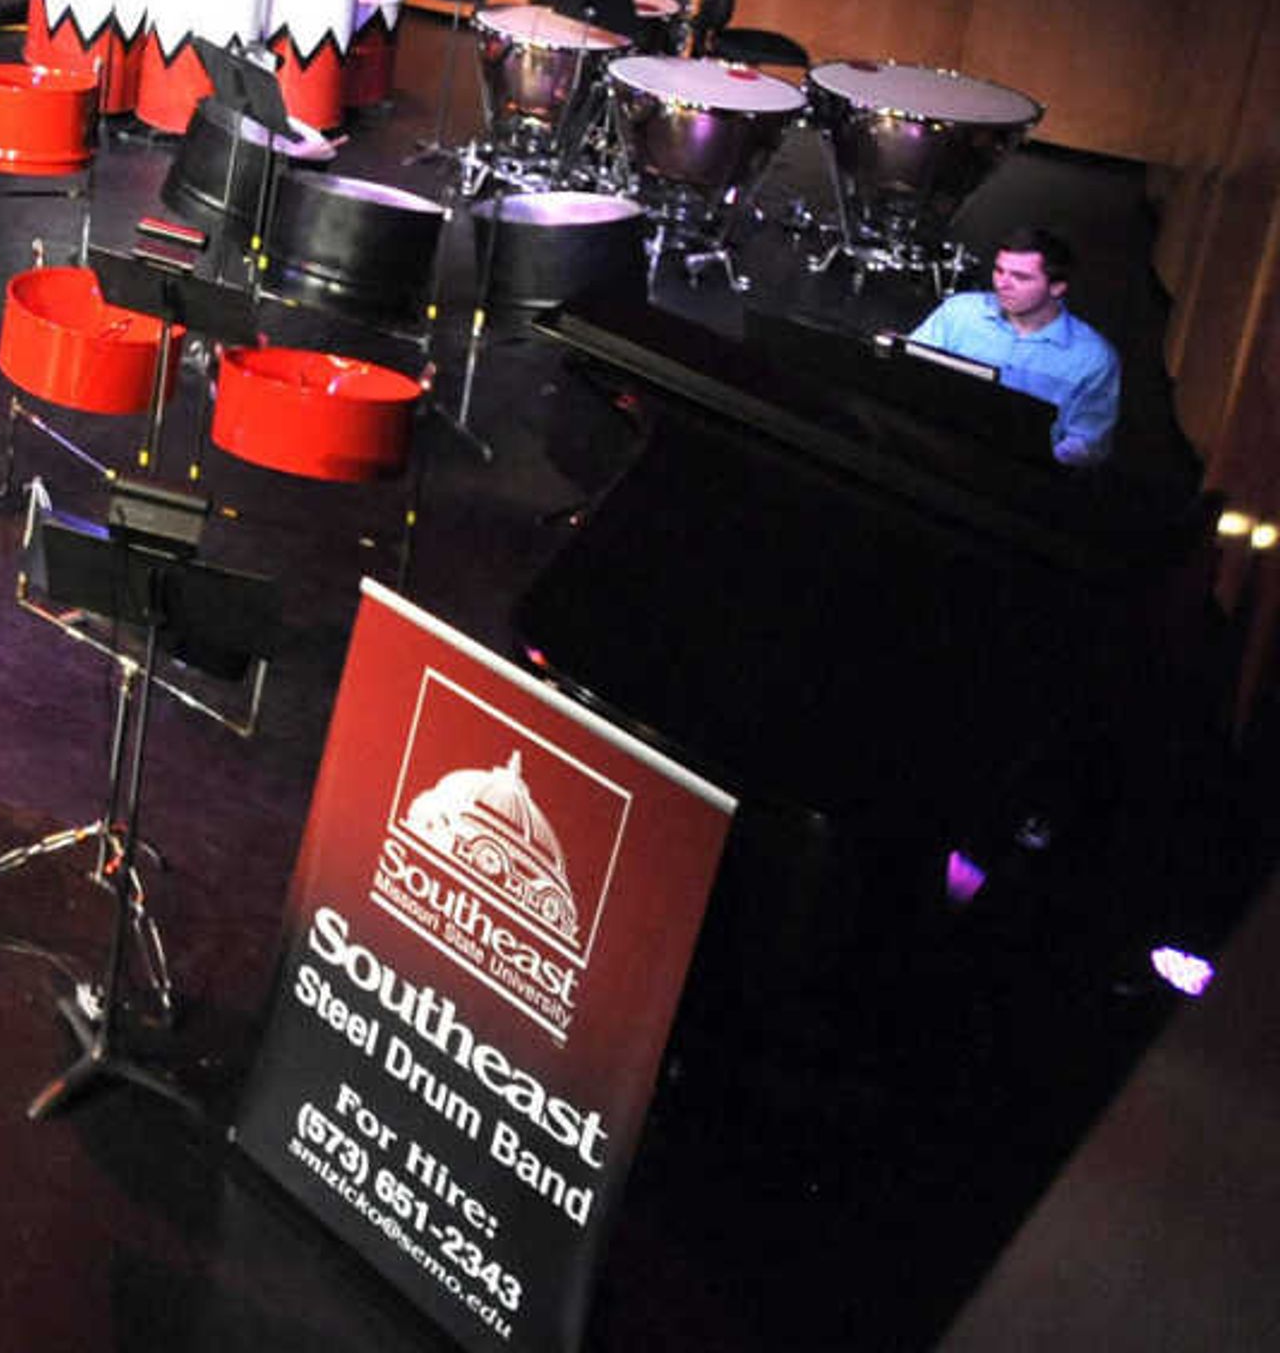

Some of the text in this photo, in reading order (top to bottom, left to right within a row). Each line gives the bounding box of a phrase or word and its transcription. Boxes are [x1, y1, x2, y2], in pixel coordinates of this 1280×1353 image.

[379, 838, 579, 1008] Southeast
[444, 920, 485, 965] State
[489, 956, 572, 1030] University
[295, 965, 593, 1226] Steel Drum Band
[309, 906, 608, 1169] Southeast
[297, 1102, 522, 1312] (573) 651-2343
[336, 1083, 499, 1239] For Hire:
